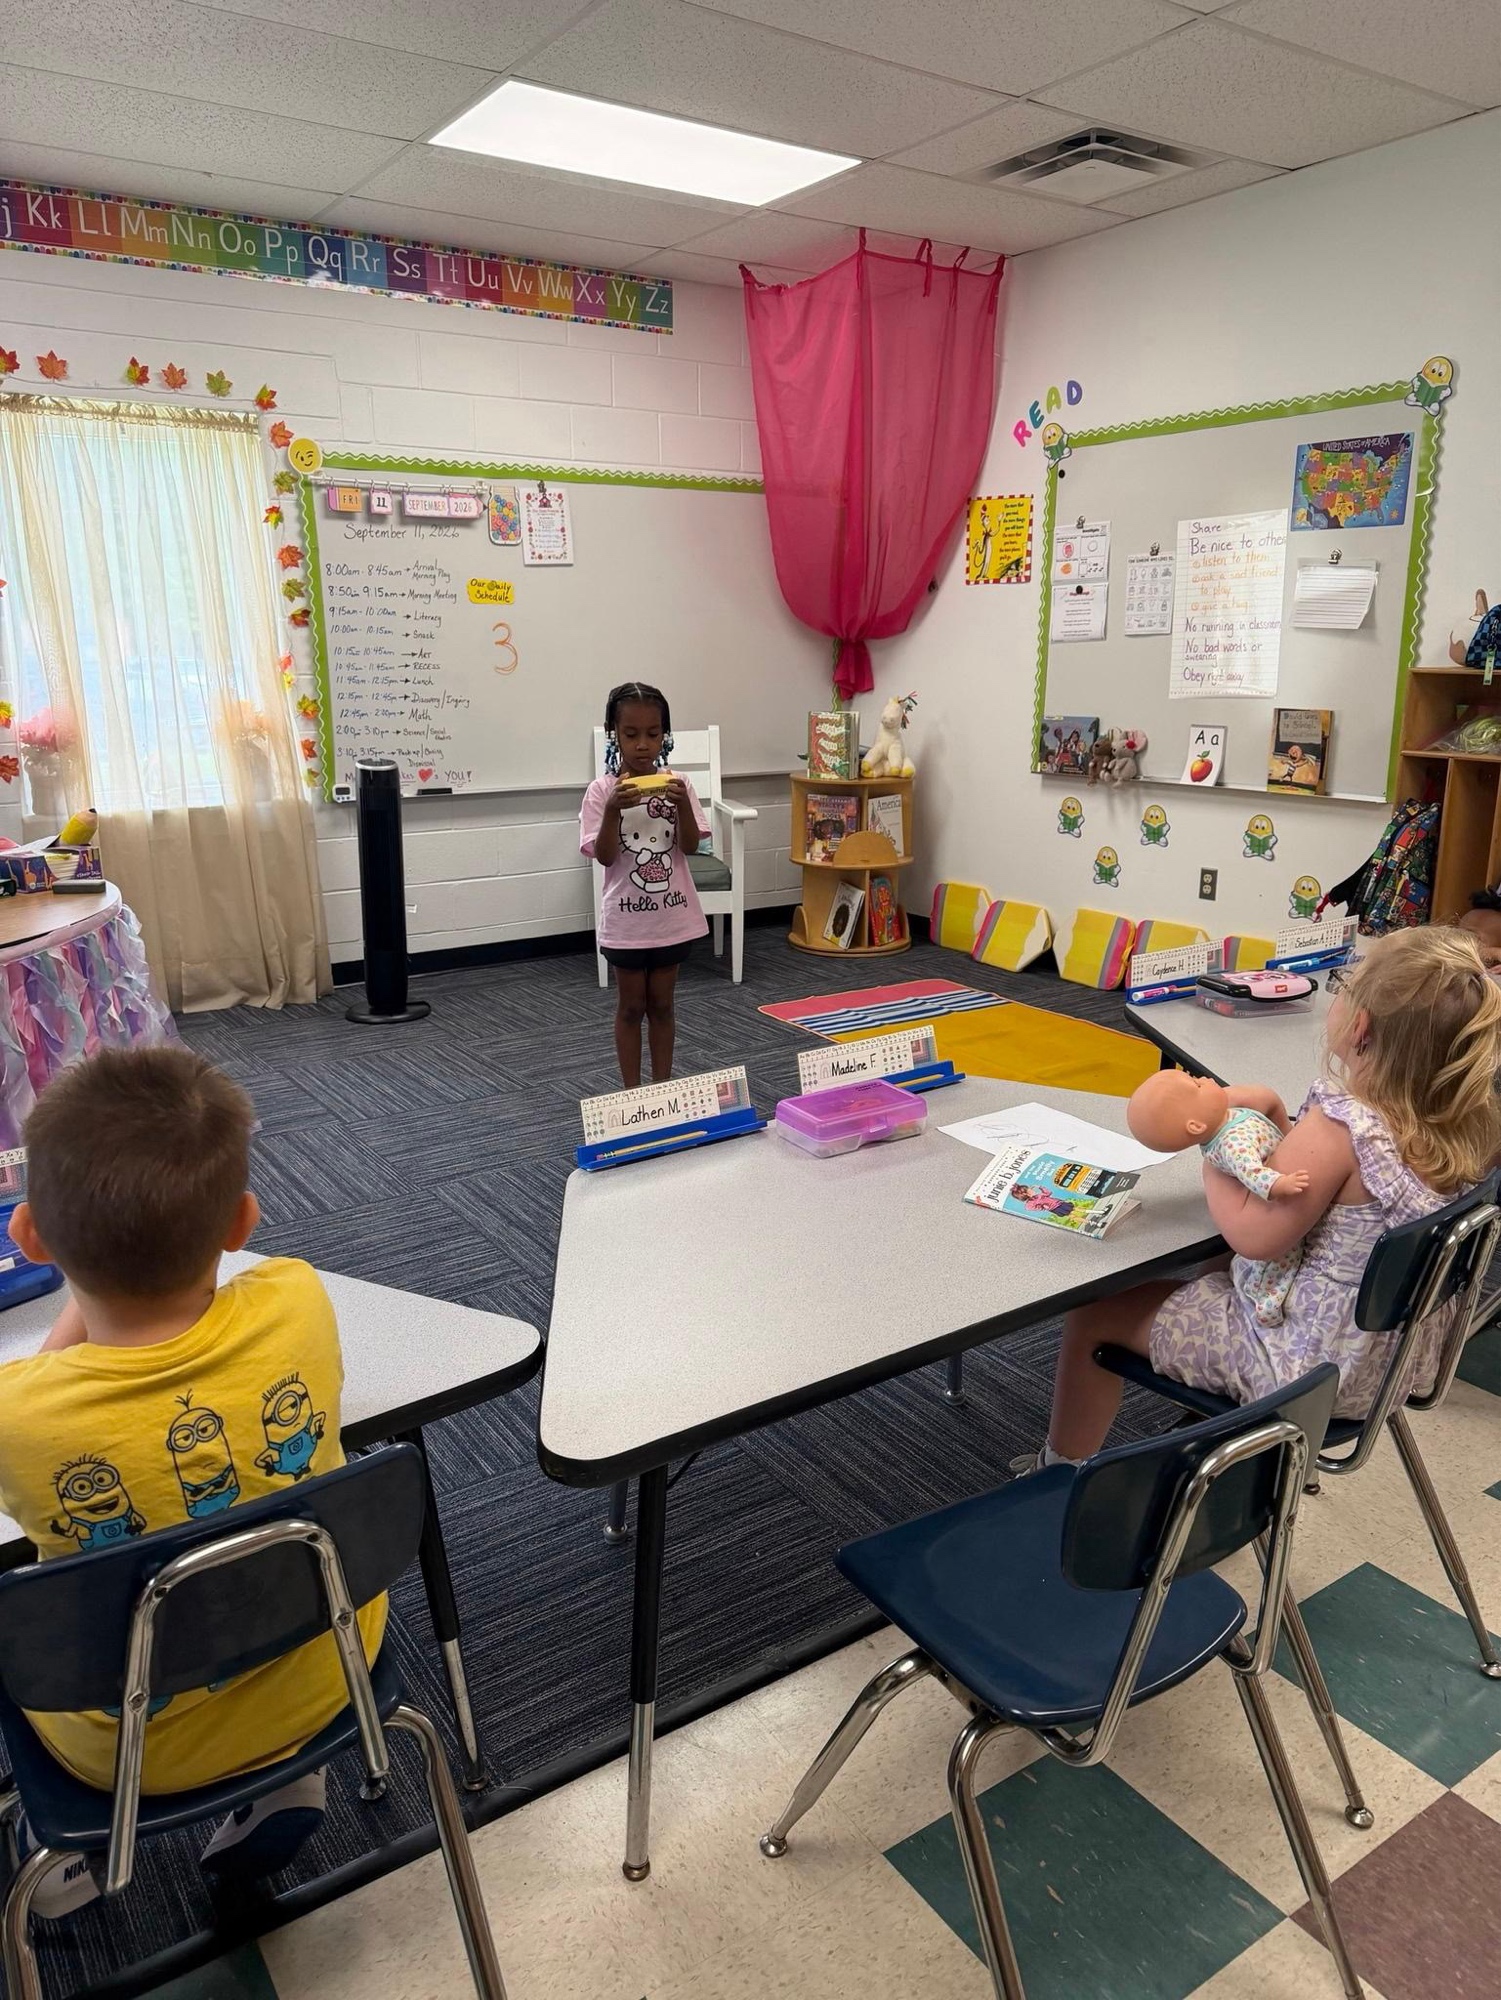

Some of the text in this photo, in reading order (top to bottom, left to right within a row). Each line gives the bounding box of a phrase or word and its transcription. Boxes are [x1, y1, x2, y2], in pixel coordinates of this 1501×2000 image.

[25, 191, 63, 229] Kk
[78, 200, 112, 236] Ll
[120, 206, 169, 245] Mm
[171, 213, 211, 250] Nn
[219, 222, 256, 256] Oo
[264, 228, 299, 274] Pp
[308, 235, 342, 281] Qq
[351, 241, 381, 273] Rr
[392, 249, 421, 279] Ss
[432, 253, 459, 285] Tt
[468, 259, 500, 290] Uu
[506, 266, 533, 295] Vv
[537, 268, 573, 300] Ww
[575, 275, 606, 305] Xx
[612, 281, 637, 321] Yy
[645, 287, 669, 314] Zz
[1013, 380, 1083, 447] READ
[343, 494, 473, 512] FRI 11 SEPTEMBER 2026
[344, 523, 406, 542] September
[414, 525, 425, 539] 11,
[1192, 522, 1221, 534] Share
[1190, 537, 1206, 556] Be
[1211, 540, 1233, 552] nice
[1240, 533, 1253, 549] to
[326, 563, 359, 576] 8:00am
[1203, 555, 1227, 567] listen
[470, 578, 486, 588] Our
[475, 590, 511, 603] Schedule
[414, 610, 441, 628] Literacy
[1185, 617, 1197, 632] No
[1202, 622, 1234, 638] running
[413, 629, 435, 639] Snack
[492, 622, 519, 676] 3
[1185, 638, 1198, 653] No
[1204, 638, 1220, 653] bad
[413, 662, 441, 670] RECESS
[1183, 667, 1205, 688] Obey
[408, 709, 432, 721] Math
[618, 891, 687, 912] Hello Kitty
[831, 1053, 877, 1077] Madeline F.
[621, 1098, 681, 1126] Lathen M.
[64, 1858, 89, 1883] NIK
